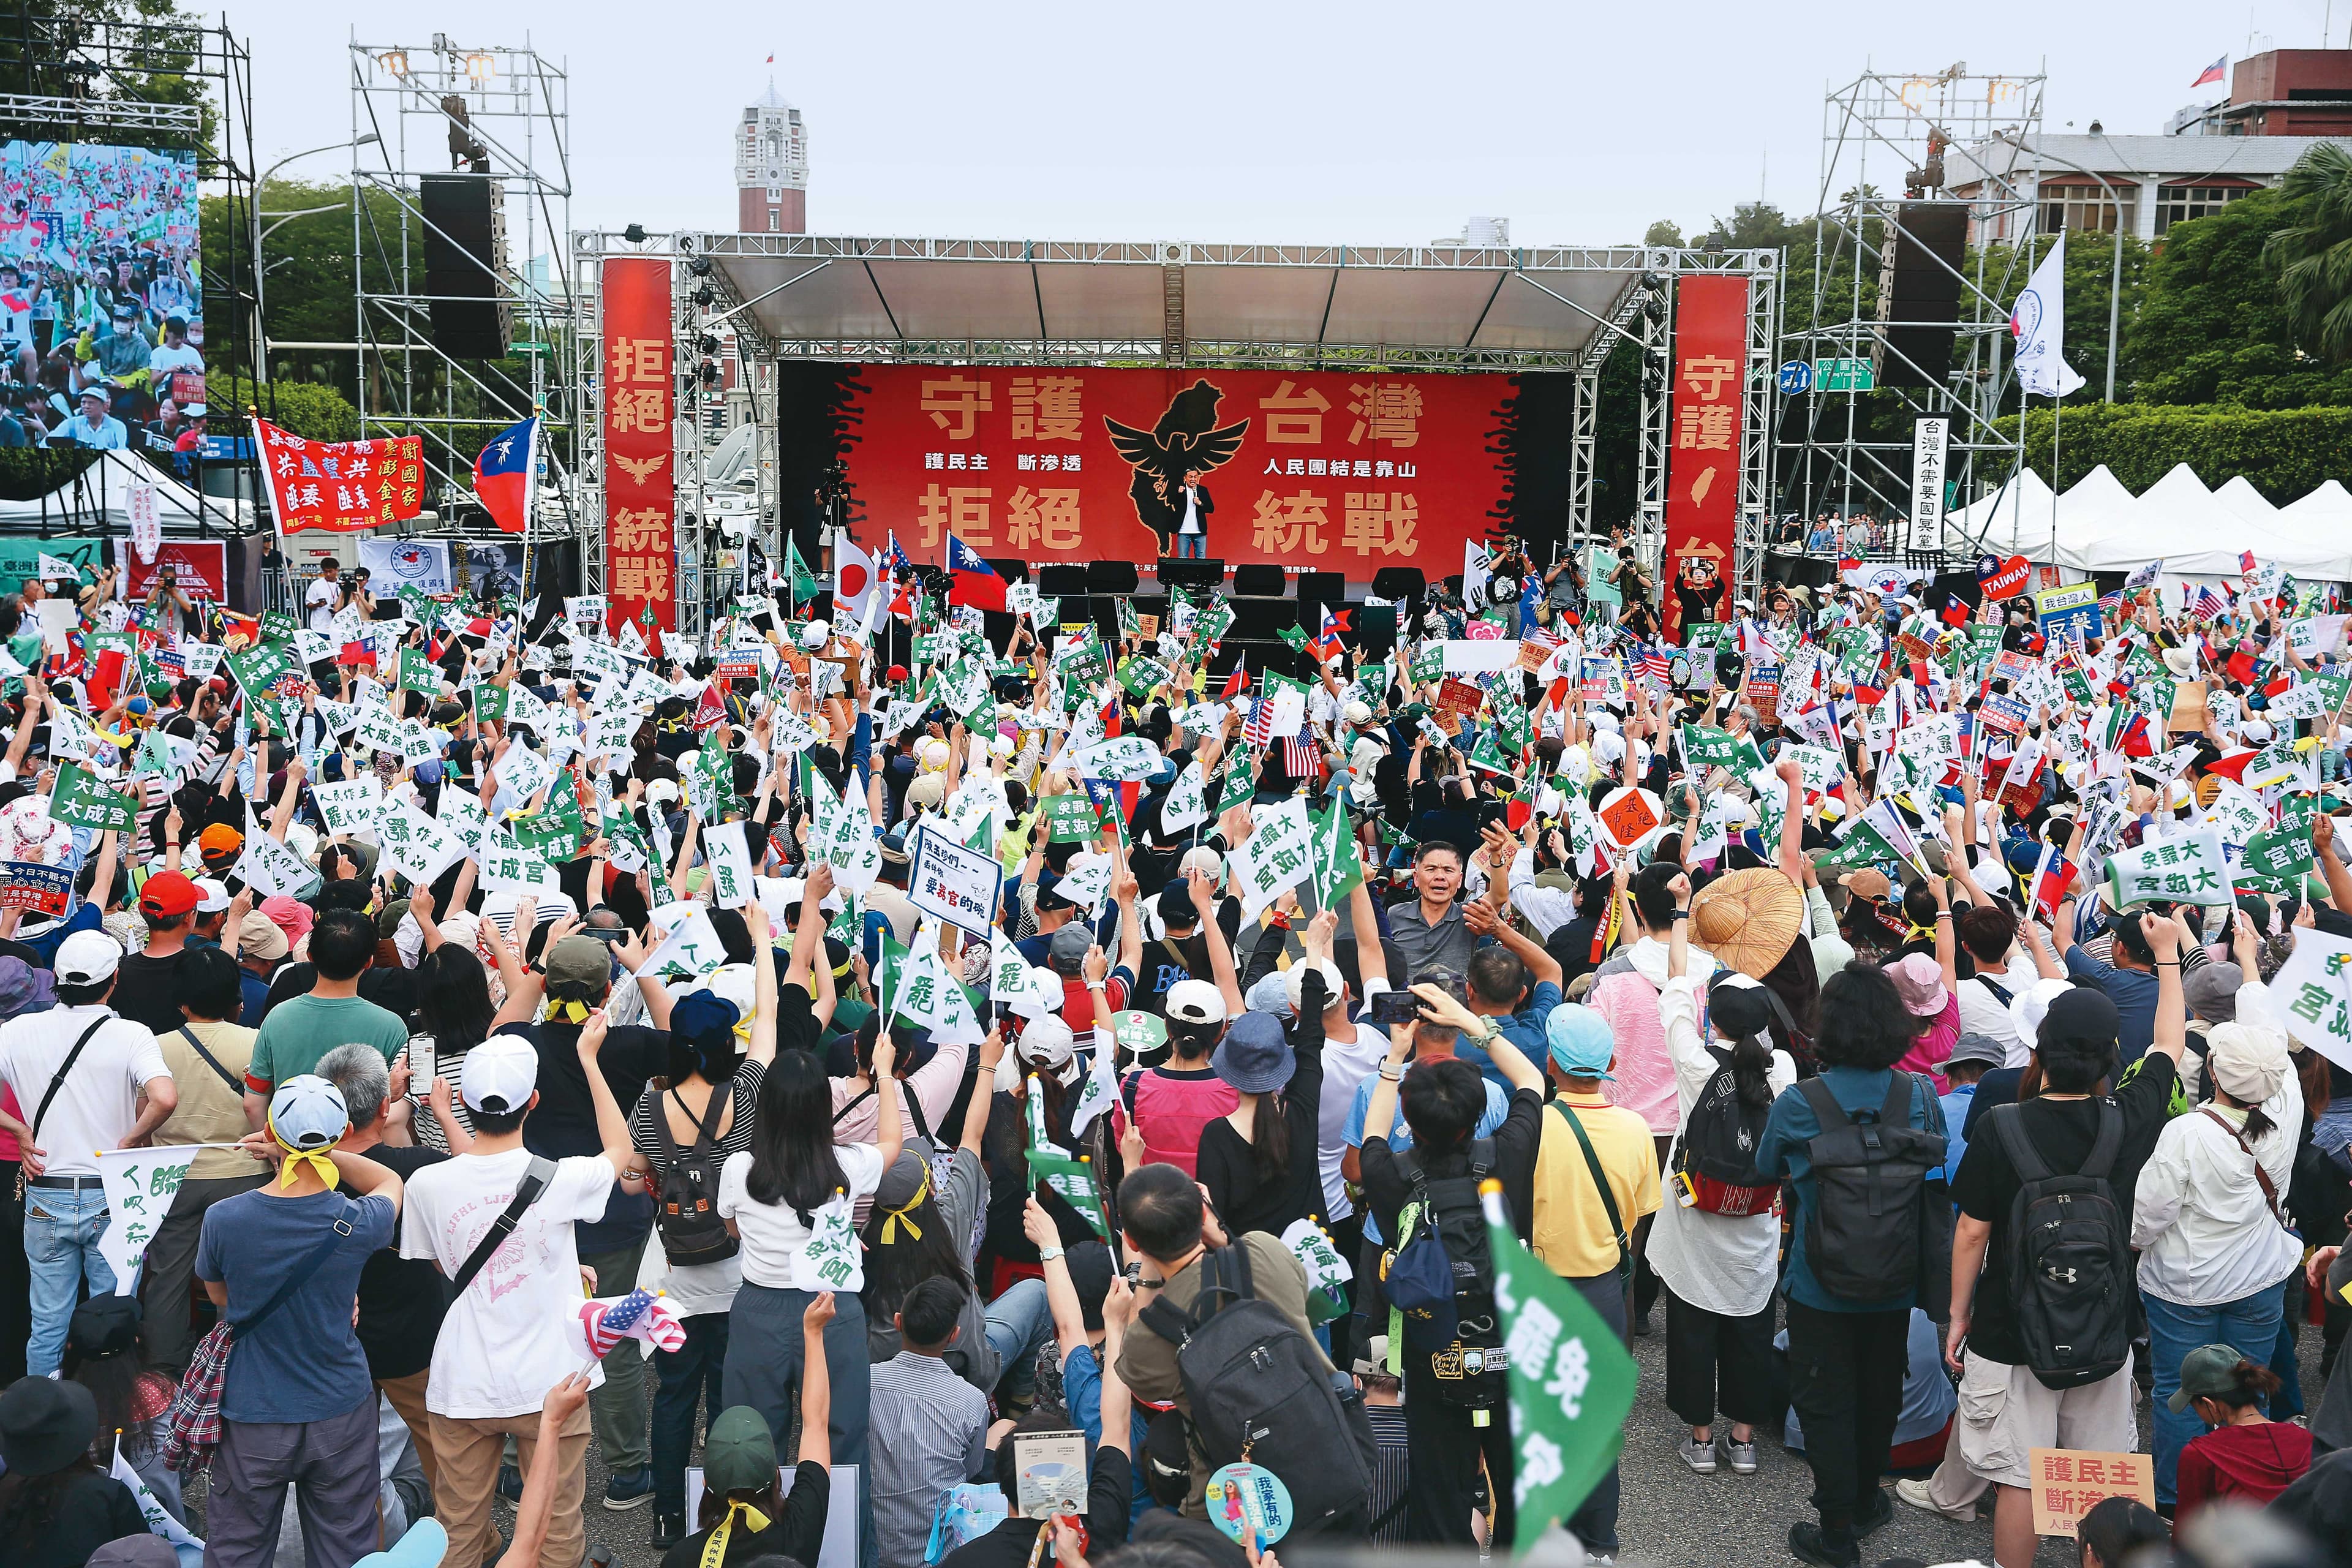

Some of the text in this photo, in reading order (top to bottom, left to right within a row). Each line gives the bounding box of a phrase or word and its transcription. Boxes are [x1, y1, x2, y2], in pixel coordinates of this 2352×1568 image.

[612, 337, 666, 433] 拒絕
[921, 375, 1424, 447] 守護 台灣
[1679, 355, 1734, 451] 守護
[401, 440, 418, 507] 衛國家
[924, 453, 1082, 472] 護民主 斷滲透
[1263, 459, 1417, 478] 人民團結是靠山
[918, 483, 1419, 557] 拒絕 統戰
[614, 507, 669, 601] 統戰
[1985, 563, 2029, 594] TAIWAN
[2045, 591, 2090, 609] 我台灣人
[245, 654, 281, 685] 大成宮
[405, 671, 439, 690] 大成宮
[597, 734, 627, 750] 大成
[1090, 741, 1147, 766] 人民作主
[1687, 743, 1733, 759] 大成宮
[319, 786, 371, 802] 人民作主
[62, 798, 129, 826] 大成宮
[13, 867, 70, 884] 今日不罷免
[1132, 1014, 1143, 1024] 2
[2043, 1455, 2139, 1487] 護民主
[1257, 1476, 1282, 1526] 我家有的
